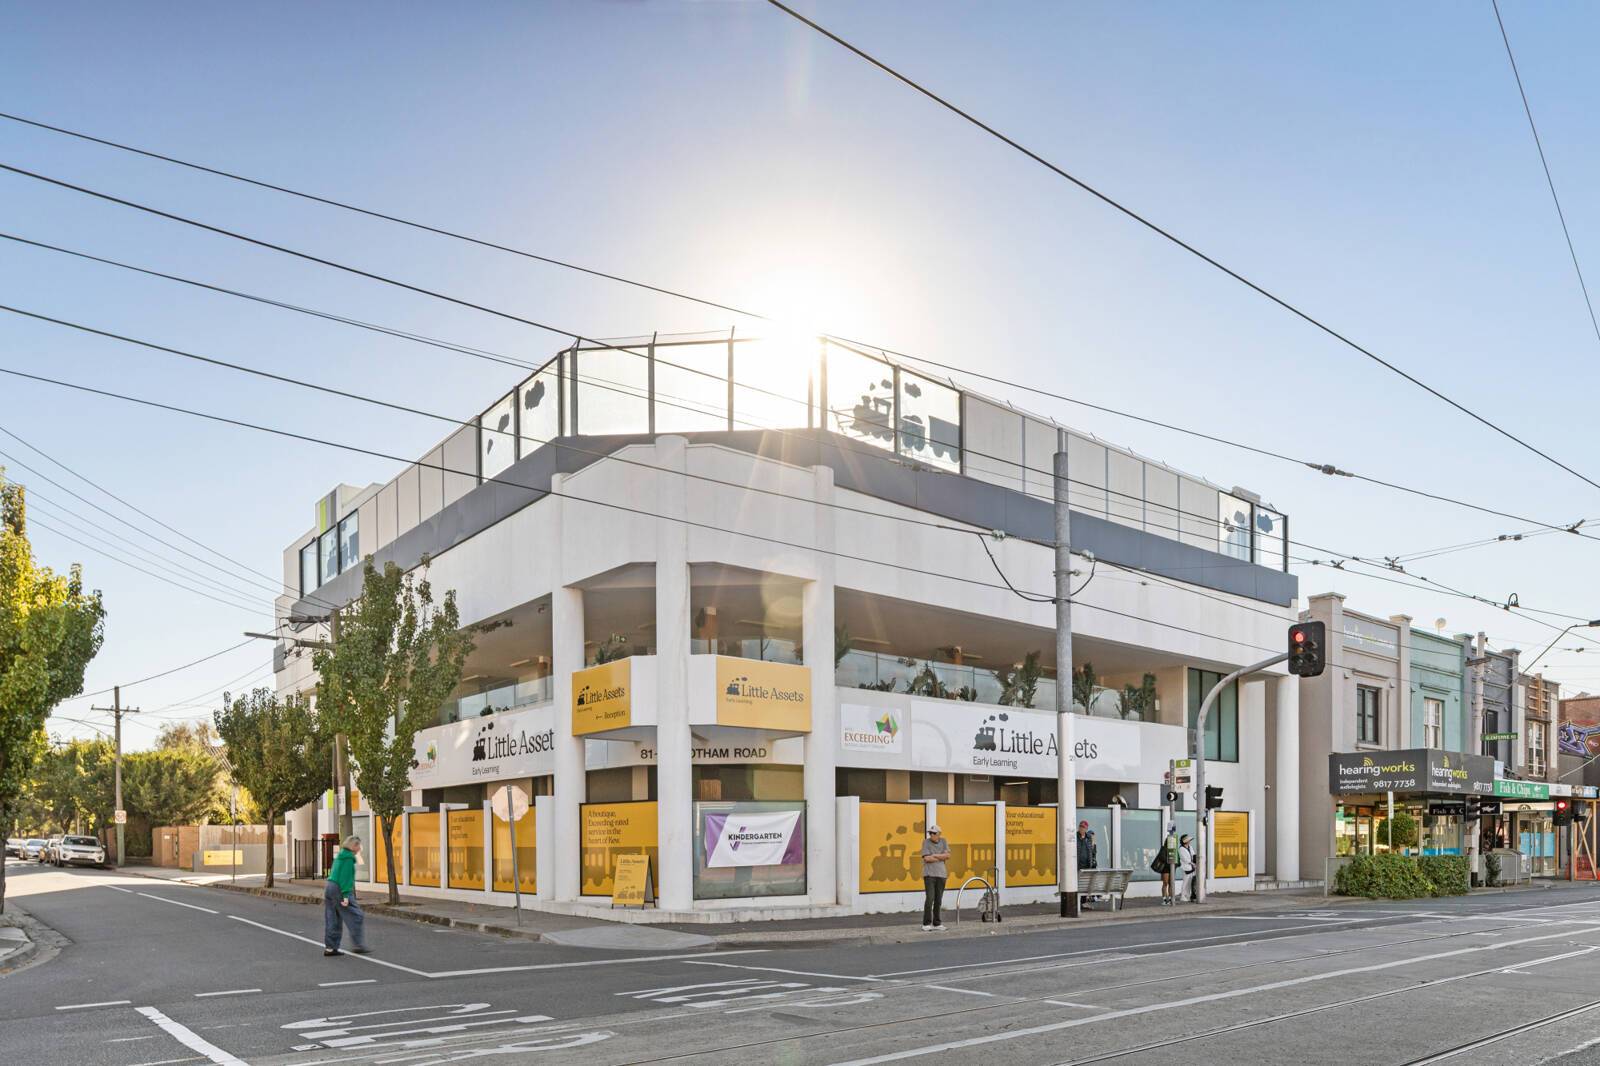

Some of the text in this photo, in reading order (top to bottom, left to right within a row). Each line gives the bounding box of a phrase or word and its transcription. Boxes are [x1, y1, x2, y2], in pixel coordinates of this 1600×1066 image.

[585, 687, 625, 704] Little Assets
[742, 684, 804, 702] Little Assets
[487, 727, 554, 760] Little Asset
[844, 732, 890, 745] EXCEEDING
[1000, 728, 1098, 759] Little Aets
[691, 747, 729, 759] OTHAM
[734, 747, 767, 759] ROAD
[973, 756, 1017, 770] Early Learning
[472, 765, 500, 775] Early Learning
[1373, 778, 1416, 789] 9817 7738
[1500, 782, 1511, 793] Fish
[728, 832, 783, 841] KINDERGARTEN
